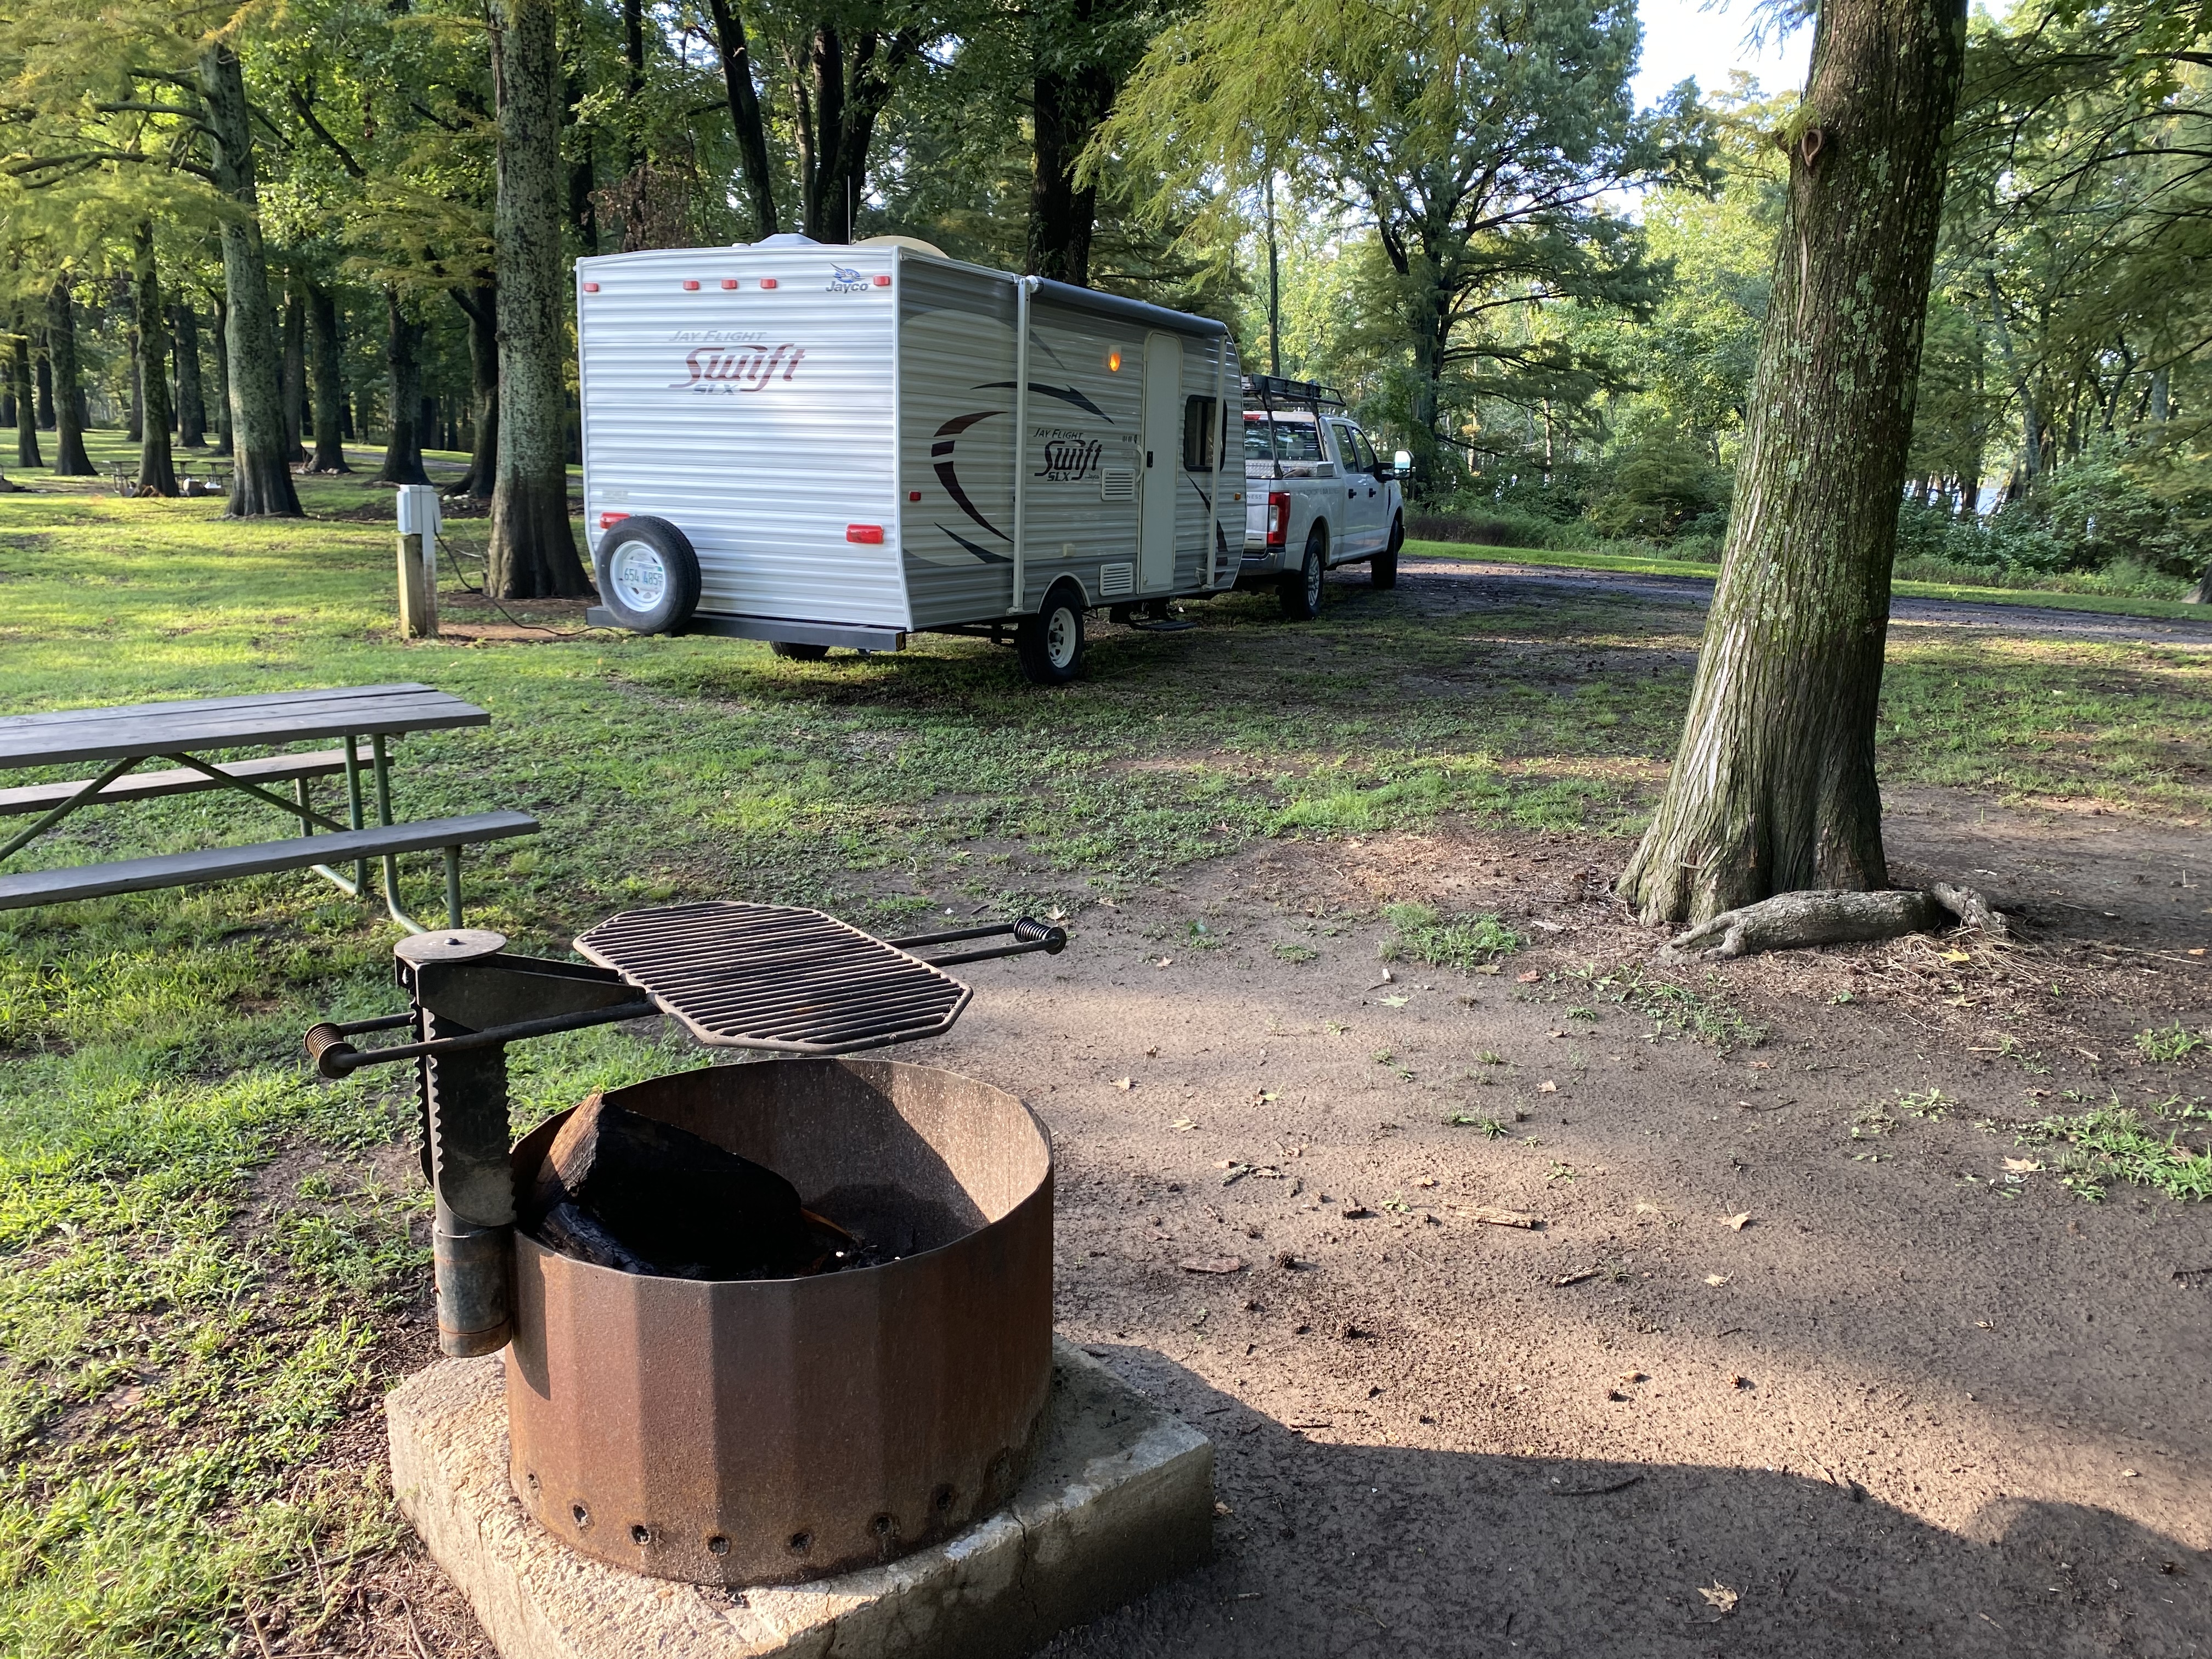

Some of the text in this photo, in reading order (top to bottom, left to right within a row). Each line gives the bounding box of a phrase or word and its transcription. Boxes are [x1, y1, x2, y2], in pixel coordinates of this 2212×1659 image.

[825, 281, 868, 294] Jayco
[668, 343, 806, 392] Swift
[692, 384, 738, 395] SLX
[1034, 439, 1103, 480] Swift
[1047, 472, 1071, 481] SLX
[624, 568, 639, 582] 654
